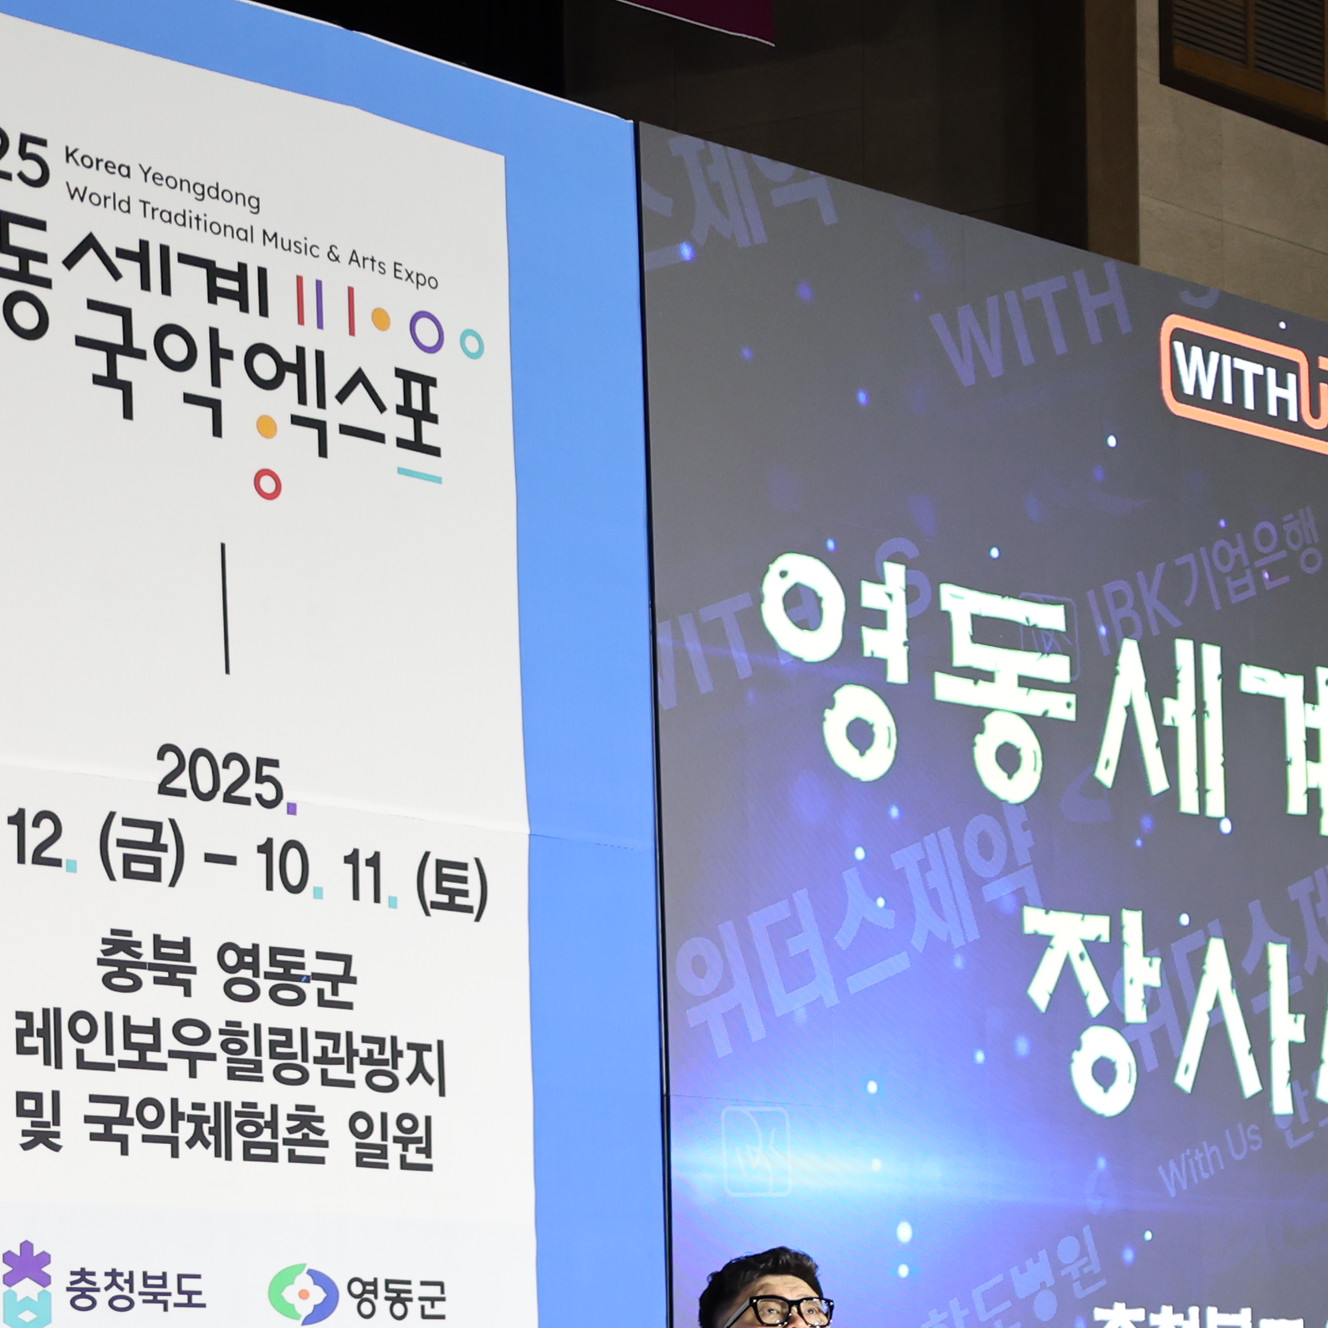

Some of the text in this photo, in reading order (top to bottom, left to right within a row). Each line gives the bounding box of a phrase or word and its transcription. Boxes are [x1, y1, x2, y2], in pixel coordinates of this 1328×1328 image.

[64, 145, 261, 215] Korea Yeongdong
[65, 181, 439, 291] World Traditional Music & Arts Expo
[75, 298, 442, 459] 국악엑스포
[1087, 506, 1324, 656] IBK기업은행
[156, 743, 297, 815] 2025.
[99, 811, 185, 887] (금)
[256, 837, 324, 900] 10.
[344, 848, 398, 909] 11.
[417, 851, 488, 922] (토)
[97, 928, 358, 1010] 충북 영동군
[675, 802, 1046, 1060] 위더스제약
[14, 1007, 447, 1097] 레인보우힐링관광지
[14, 1090, 434, 1172] 및 국악체험촌 일원
[65, 1267, 207, 1313] 충청북도
[347, 1277, 447, 1320] 영동군
